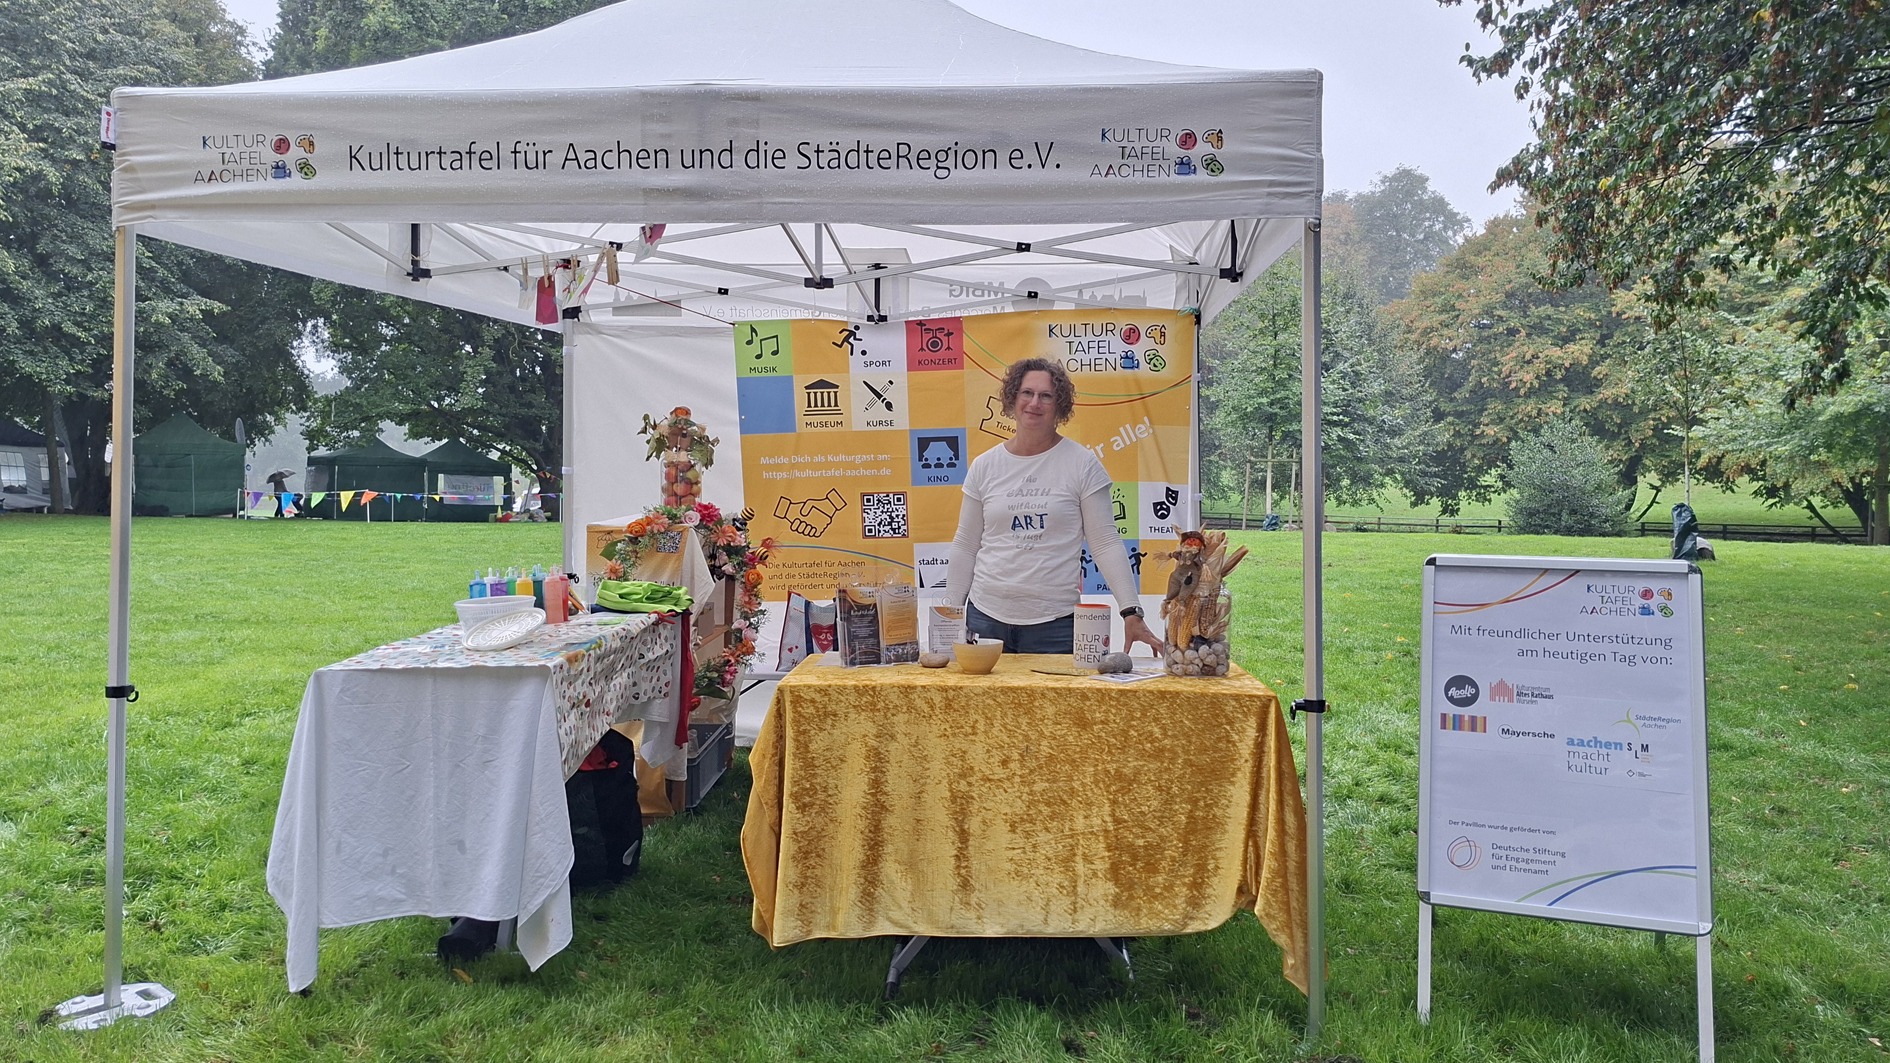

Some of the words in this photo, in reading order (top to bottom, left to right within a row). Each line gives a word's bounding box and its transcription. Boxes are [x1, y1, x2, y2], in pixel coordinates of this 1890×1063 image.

[202, 134, 266, 150] KULTUR
[1101, 128, 1171, 143] KULTUR
[218, 151, 267, 166] TAFEL
[349, 141, 500, 172] Kulturtafel
[511, 141, 553, 170] für
[561, 140, 669, 170] Aachen
[681, 140, 733, 169] und
[744, 140, 786, 169] die
[796, 140, 998, 180] StädteRegion
[1008, 141, 1061, 169] e.V.
[1118, 146, 1170, 161] TAFEL
[193, 168, 268, 184] AACHEN
[1090, 163, 1171, 178] AACHEN
[1048, 322, 1116, 338] KULTUR
[1065, 340, 1116, 355] TAFEL
[863, 359, 892, 368] SPORT
[917, 357, 958, 366] KONZERT
[1056, 357, 1117, 373] CHEN
[749, 365, 778, 374] MUSIK
[805, 420, 844, 429] MUSEUM
[866, 419, 895, 427] KURSE
[996, 420, 1017, 434] Ticke
[1109, 416, 1154, 451] alle!
[760, 456, 789, 465] Melde
[791, 455, 811, 464] Dich
[813, 454, 825, 463] als
[827, 453, 874, 464] Kulturgast
[763, 467, 892, 480] https://kulturtafel-aachen.de
[927, 474, 949, 483] KINO
[1011, 513, 1048, 531] ART
[1149, 526, 1174, 534] THEAT
[768, 562, 781, 570] Die
[782, 561, 823, 569] Kulturtafel
[824, 560, 836, 568] für
[918, 557, 938, 566] stadt
[769, 583, 786, 591] wird
[787, 582, 824, 591] gefördert
[1586, 583, 1636, 595] KULTUR
[1599, 595, 1636, 606] TAFEL
[1579, 605, 1636, 617] AACHEN
[1450, 624, 1473, 636] Mit
[1476, 625, 1562, 641] freundlicher
[1566, 631, 1673, 650] Unterstützung
[1074, 653, 1101, 663] CHEN
[1517, 648, 1539, 658] am
[1543, 647, 1606, 665] heutigen
[1611, 651, 1637, 666] Tag
[1641, 655, 1673, 666] von:
[1448, 684, 1476, 699] Apollo
[1530, 692, 1554, 700] Rathaus
[1634, 714, 1682, 724] StädteRegion
[1641, 722, 1667, 730] Aachen
[1501, 728, 1556, 739] Mayersche
[1566, 736, 1624, 751] aachen
[1567, 750, 1611, 762] macht
[1567, 760, 1609, 776] kultur
[1461, 820, 1486, 829] Pavillon
[1509, 825, 1541, 834] gefördert
[1491, 842, 1531, 854] Deutsche
[1532, 847, 1567, 858] Stiftung
[1491, 852, 1503, 861] für
[1505, 854, 1557, 867] Engagement
[1491, 863, 1507, 871] und
[1509, 864, 1549, 876] Ehrenamt
